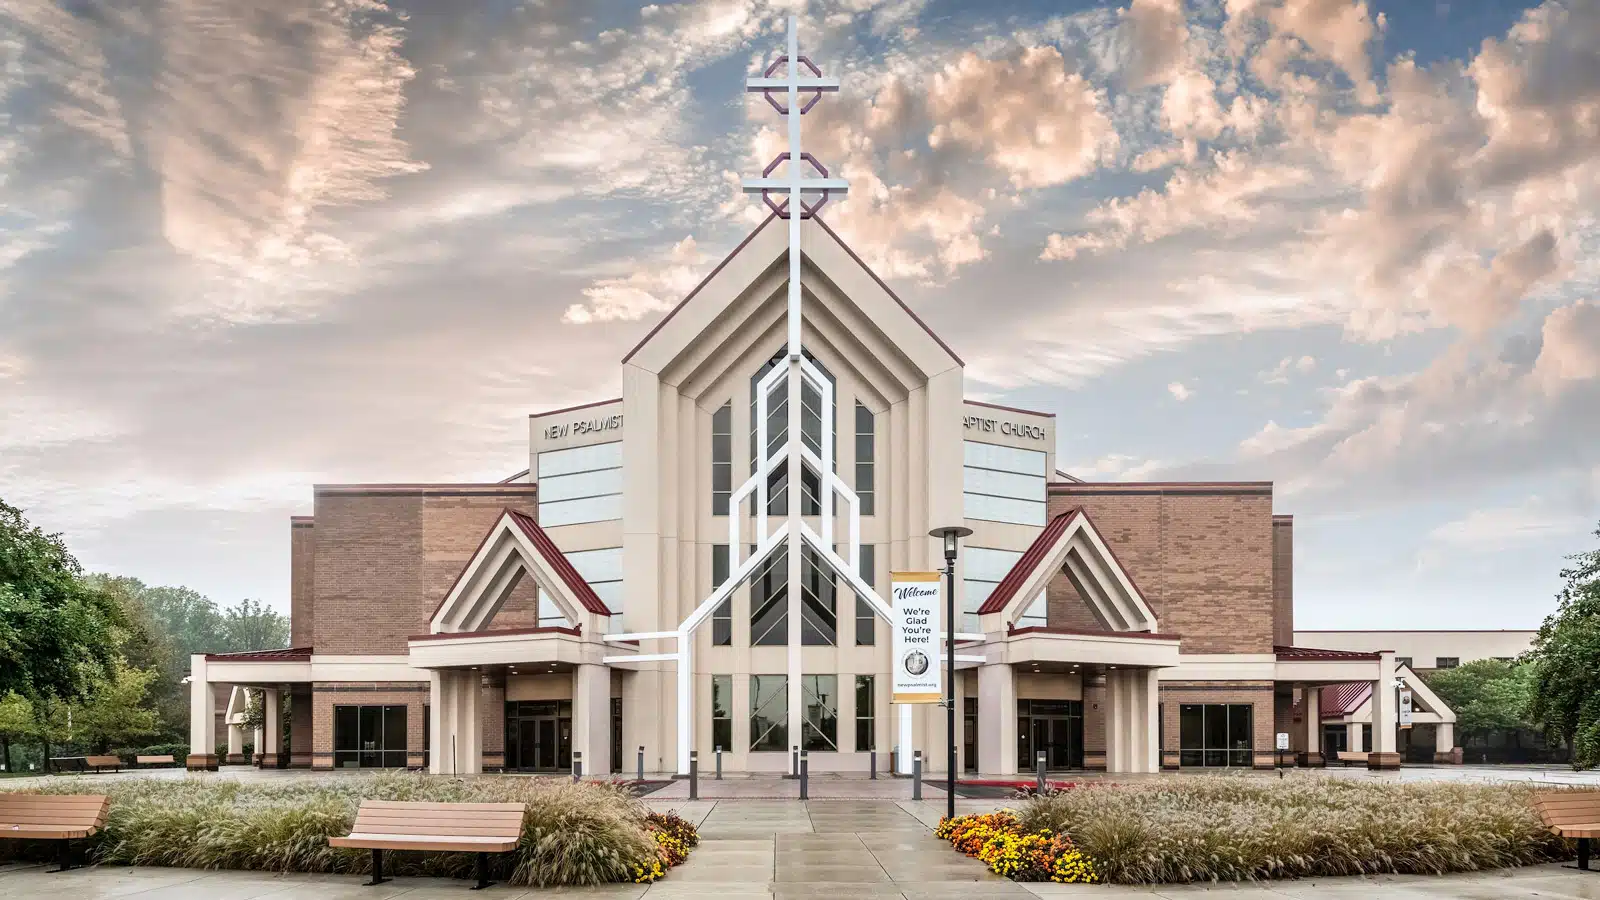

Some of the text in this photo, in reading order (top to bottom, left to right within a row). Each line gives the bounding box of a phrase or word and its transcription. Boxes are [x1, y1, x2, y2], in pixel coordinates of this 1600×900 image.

[544, 415, 624, 440] NEW PSALMIST
[963, 415, 1045, 440] APTIST CHURCH
[894, 586, 938, 600] Welcome
[903, 608, 931, 616] We're
[906, 617, 928, 625] Glad
[902, 626, 932, 634] You're
[904, 636, 930, 644] Here!
